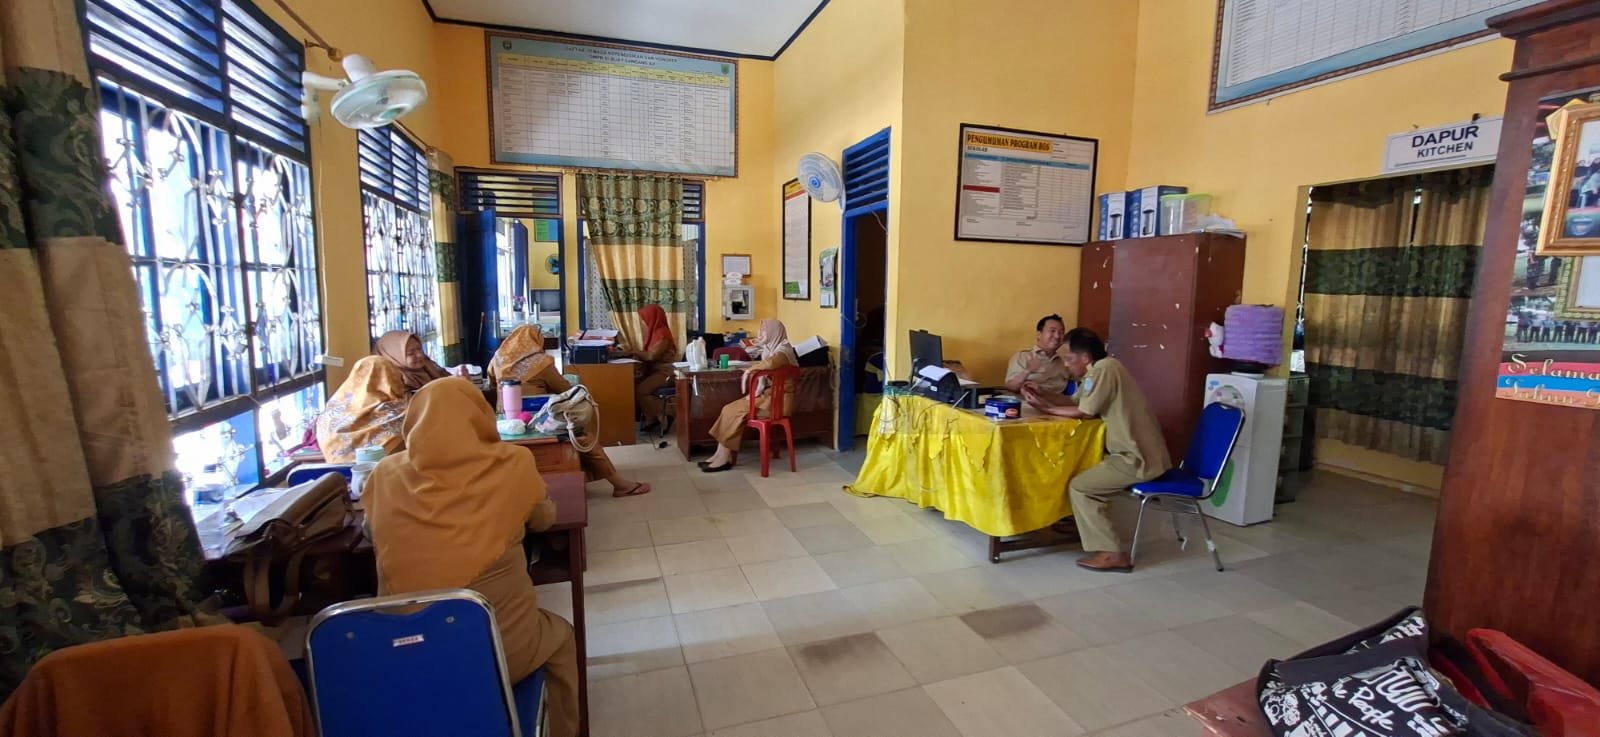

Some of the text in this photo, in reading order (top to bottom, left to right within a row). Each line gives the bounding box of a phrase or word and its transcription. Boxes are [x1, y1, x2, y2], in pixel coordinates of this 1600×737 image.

[967, 134, 1008, 147] PENGUMUMAN
[1010, 139, 1038, 150] PROGRAM
[1411, 125, 1480, 148] DAPUR
[1416, 141, 1474, 158] KITCHEN
[1347, 686, 1395, 731] People
